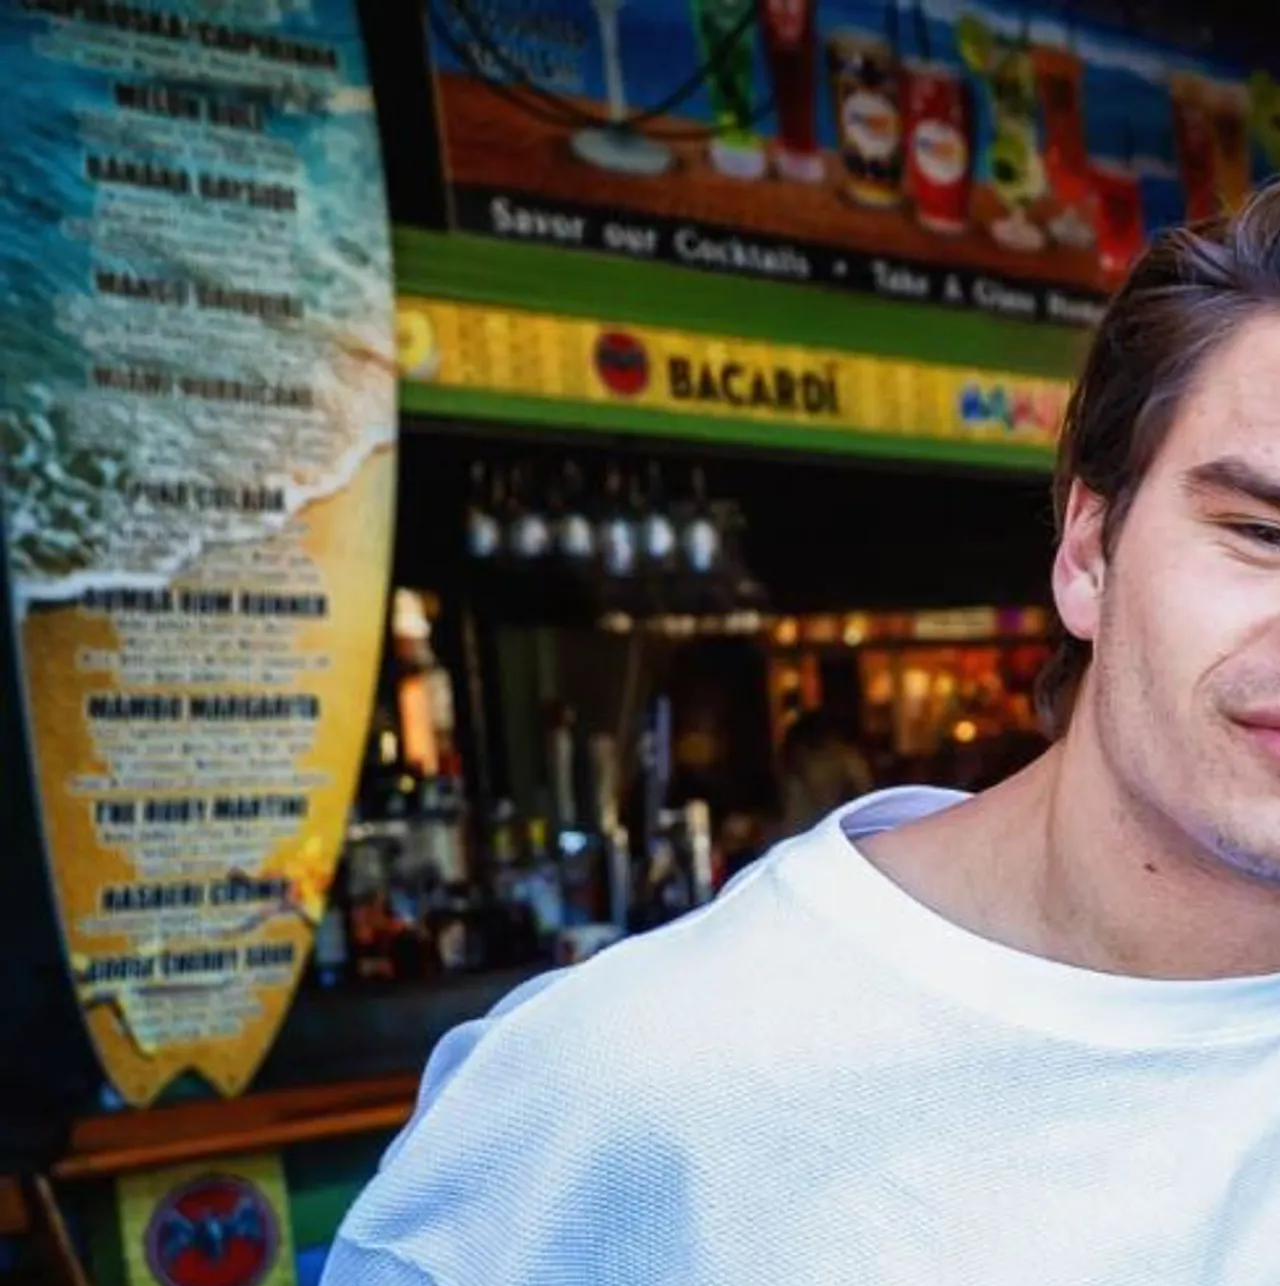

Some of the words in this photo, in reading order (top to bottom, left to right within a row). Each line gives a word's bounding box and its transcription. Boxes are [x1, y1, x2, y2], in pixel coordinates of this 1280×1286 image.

[491, 197, 586, 239] Savor
[604, 223, 657, 252] our
[675, 228, 812, 277] Cocktails
